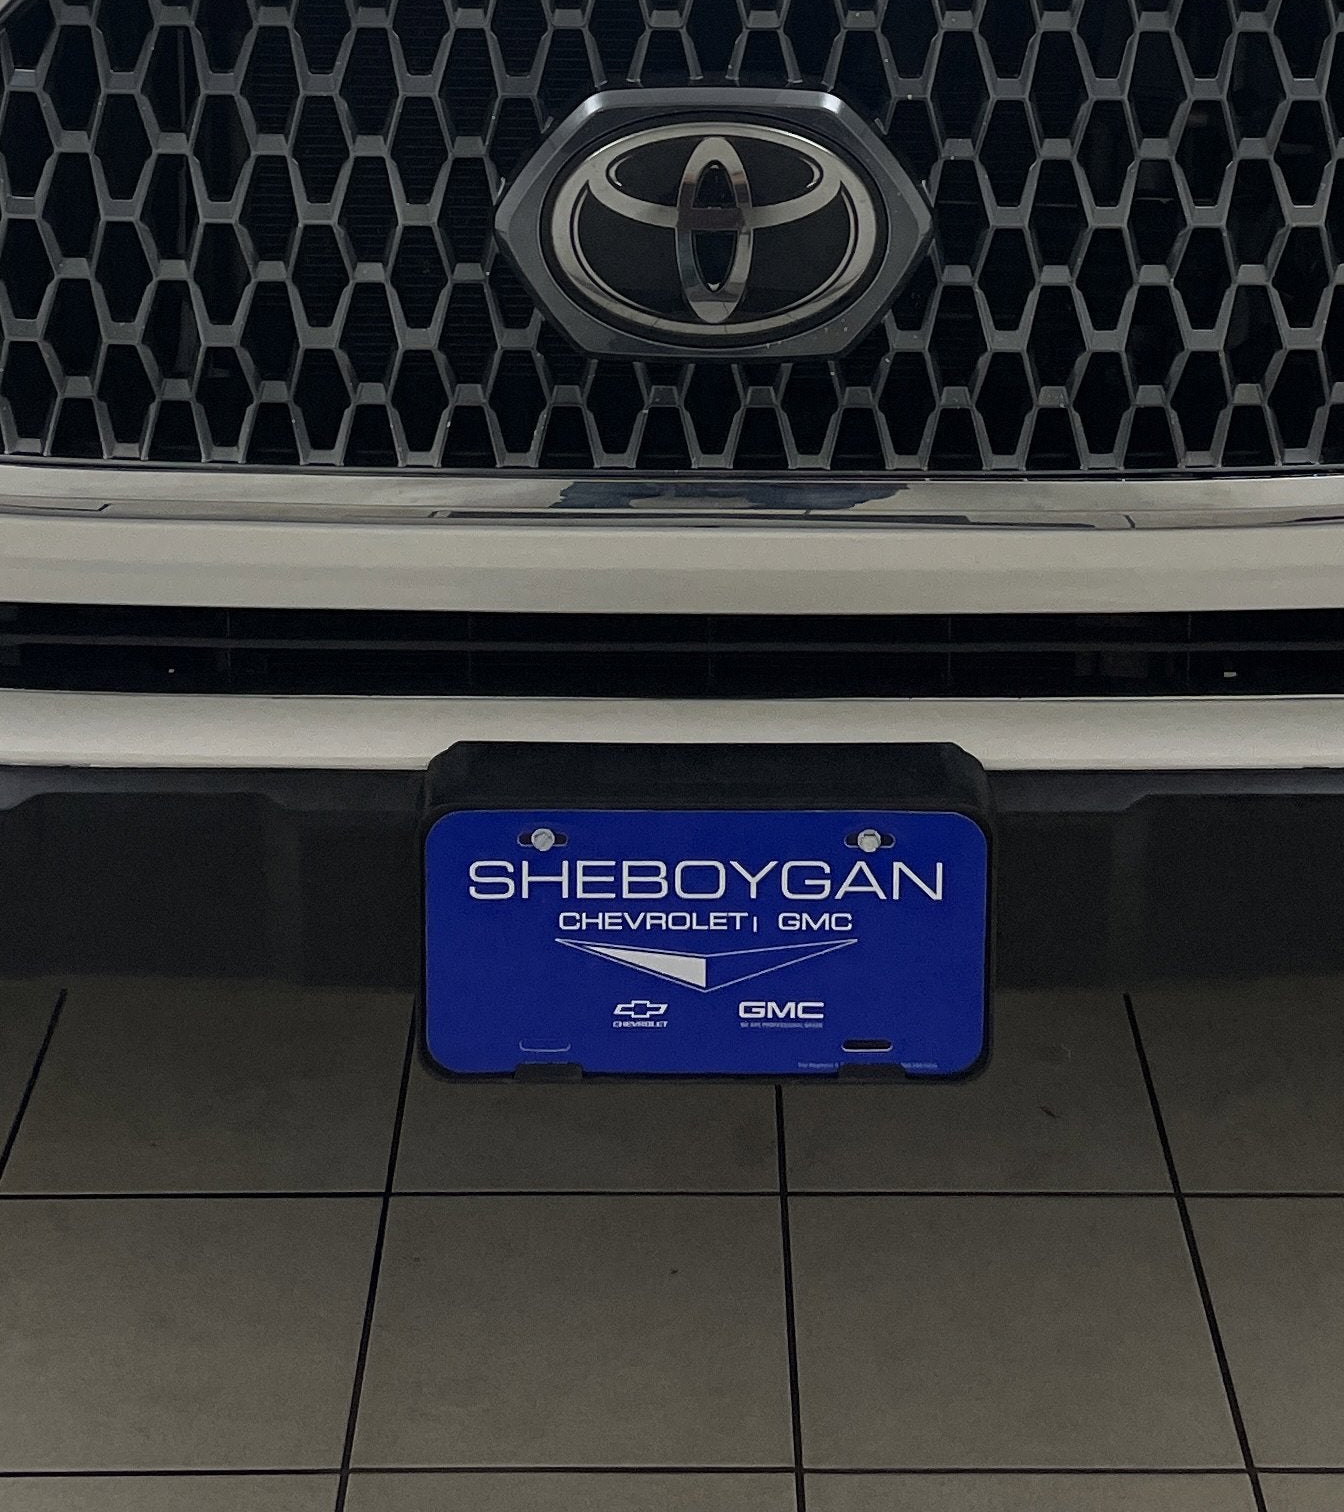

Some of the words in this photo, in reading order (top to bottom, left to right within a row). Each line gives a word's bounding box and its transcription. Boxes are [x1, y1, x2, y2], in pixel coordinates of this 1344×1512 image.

[469, 860, 943, 900] SHEBOYGAN
[559, 912, 748, 930] CHEVROLET
[778, 912, 852, 931] GMC
[738, 1001, 824, 1019] GMC
